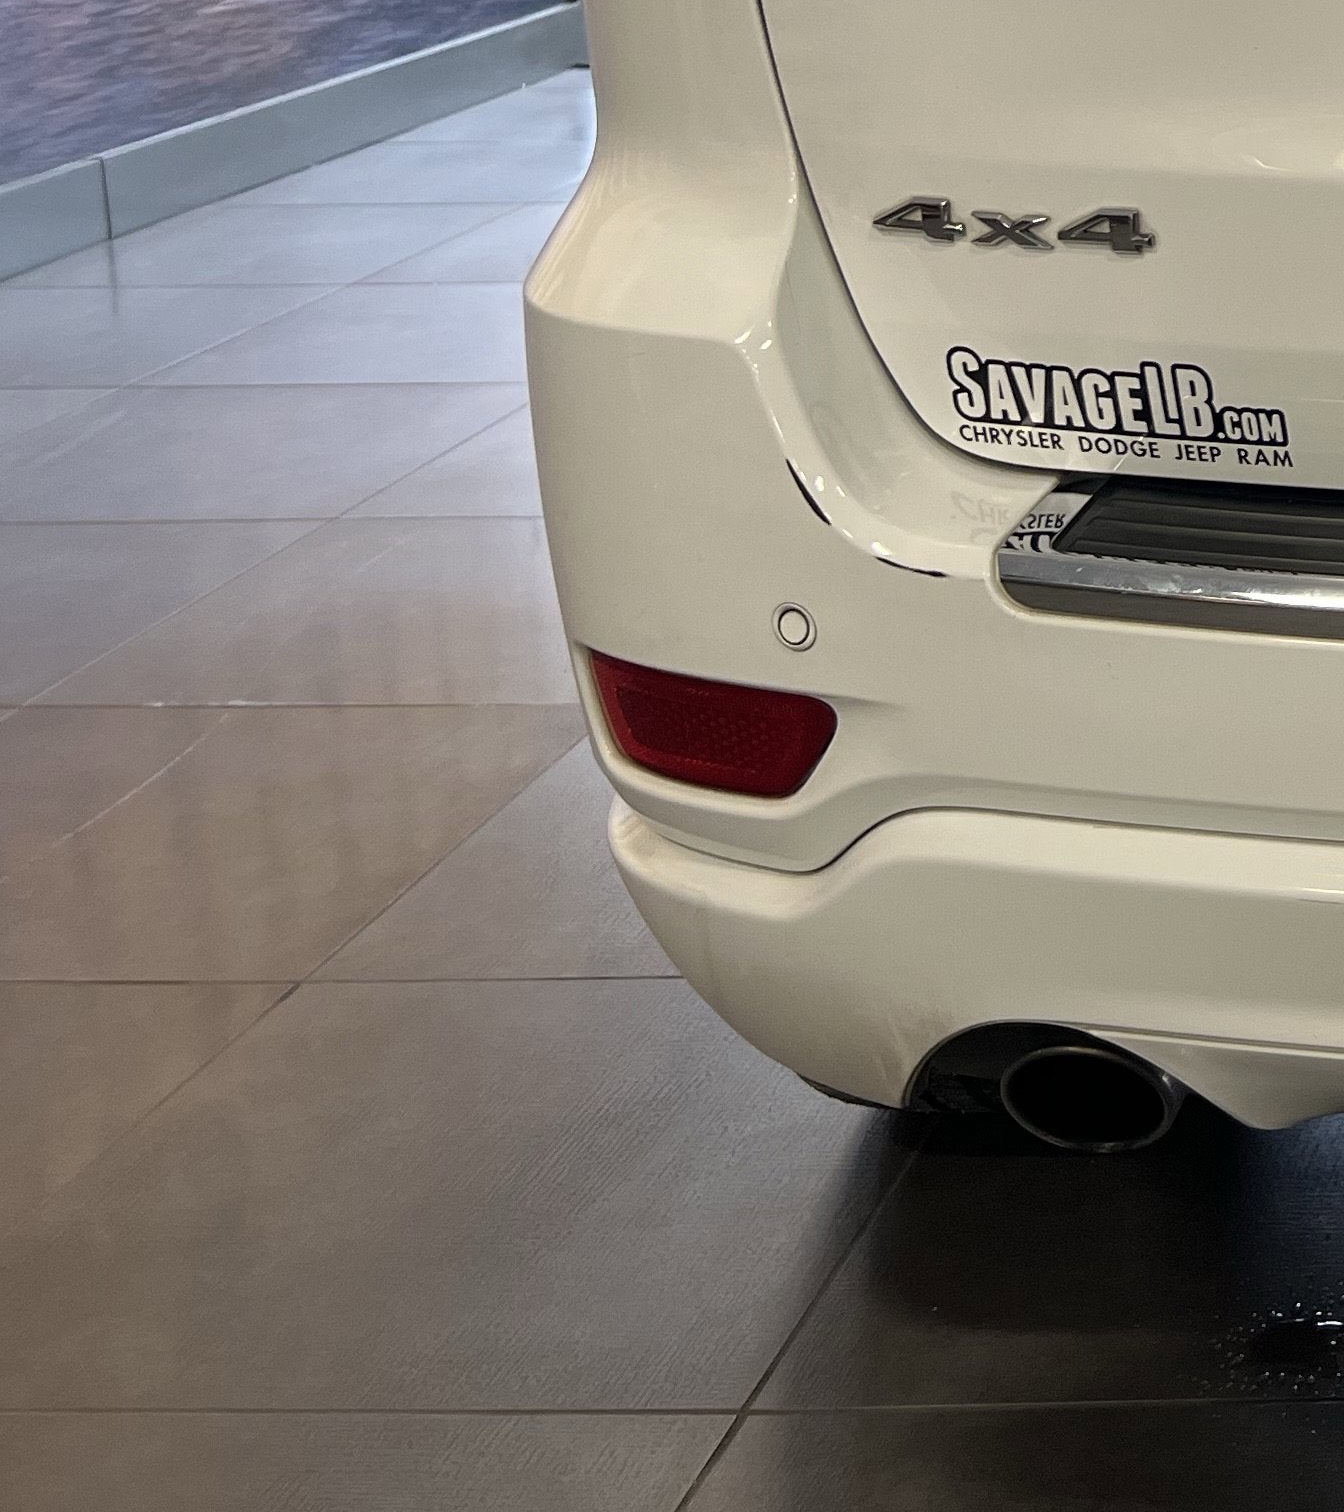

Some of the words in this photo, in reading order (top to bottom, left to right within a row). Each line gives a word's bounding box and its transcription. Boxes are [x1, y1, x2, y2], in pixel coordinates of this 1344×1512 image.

[873, 195, 1156, 254] 4x4
[958, 424, 1065, 451] CHRYSLER
[1079, 436, 1161, 459] DODGE
[1174, 444, 1222, 463] JEEP
[1237, 448, 1294, 468] RAM
